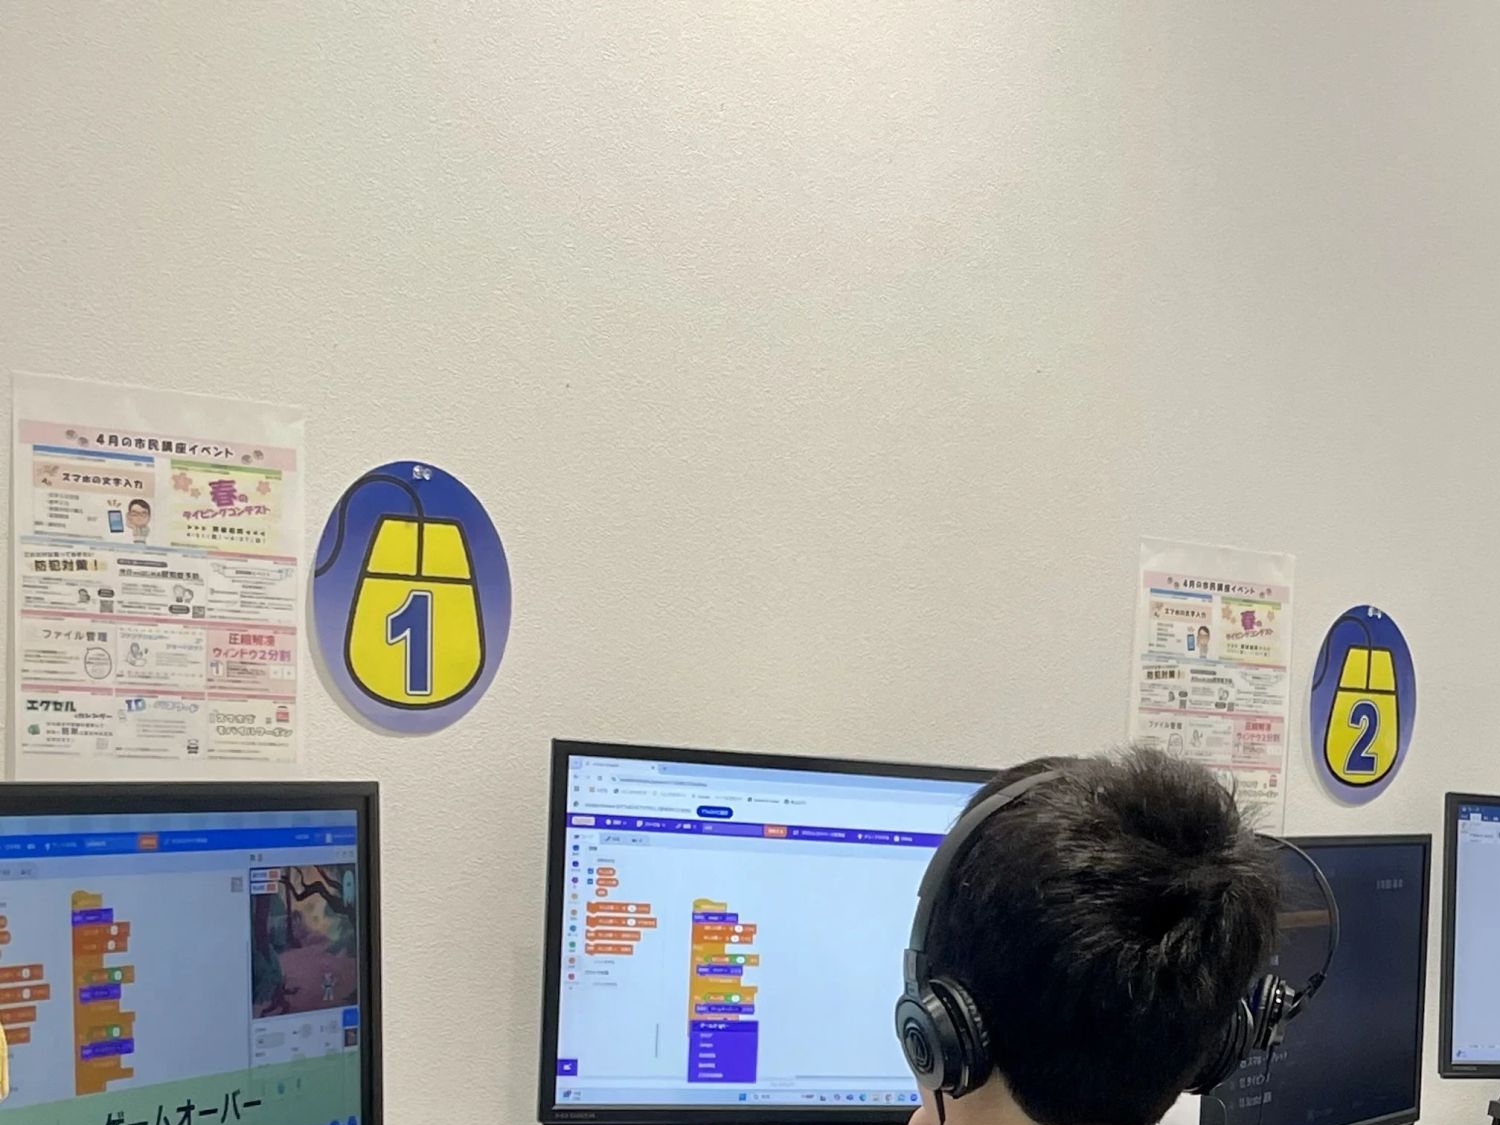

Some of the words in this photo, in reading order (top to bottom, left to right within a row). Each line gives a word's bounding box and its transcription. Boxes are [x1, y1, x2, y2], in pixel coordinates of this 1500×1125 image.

[95, 433, 234, 459] 4月の市民講座イベント
[61, 472, 144, 490] スマホの文字入力
[182, 505, 271, 520] タイピングコンテスト
[1183, 579, 1256, 596] 4月の市民講座イベント
[42, 629, 108, 643] ファイル管理
[228, 632, 276, 647] 圧縮解凍
[386, 590, 432, 696] 1
[212, 647, 292, 662] ウィンドウ2分割
[26, 699, 77, 713] エクセル
[1343, 699, 1381, 775] 2
